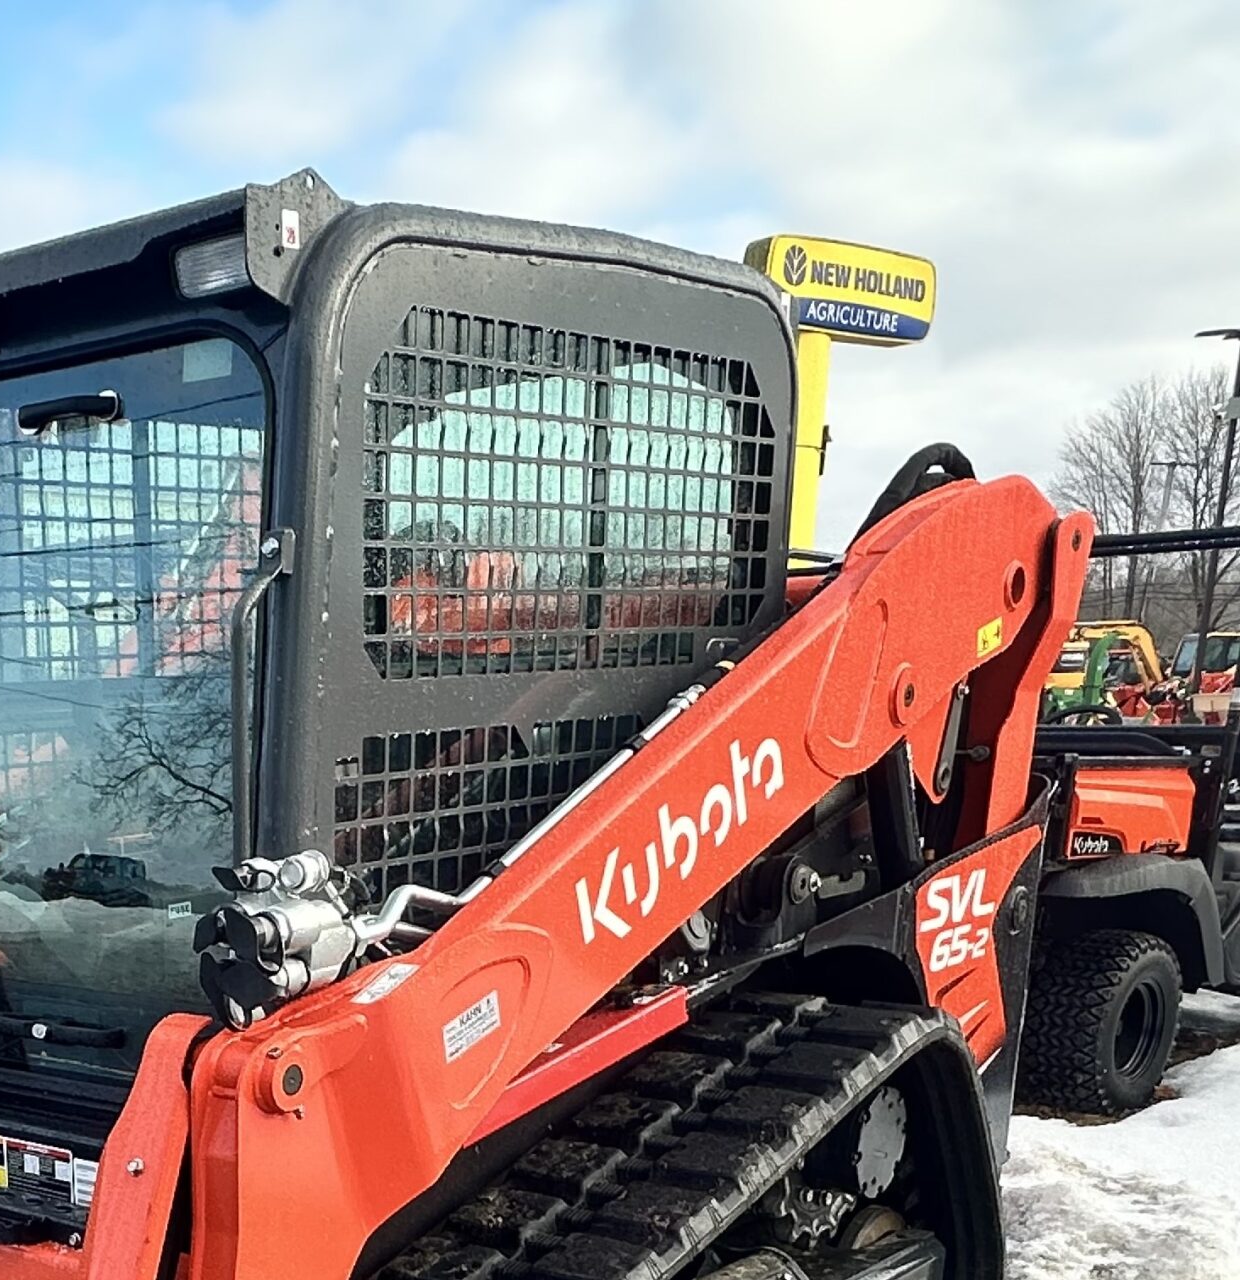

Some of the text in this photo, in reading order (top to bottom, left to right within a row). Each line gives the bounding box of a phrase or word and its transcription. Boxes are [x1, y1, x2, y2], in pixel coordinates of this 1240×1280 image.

[810, 260, 926, 302] NEW HOLLAND
[806, 300, 898, 332] AGRICULTURE
[575, 737, 785, 945] Kubota
[1073, 835, 1109, 854] Kubota
[919, 868, 996, 933] SVL
[928, 923, 990, 973] 65-2
